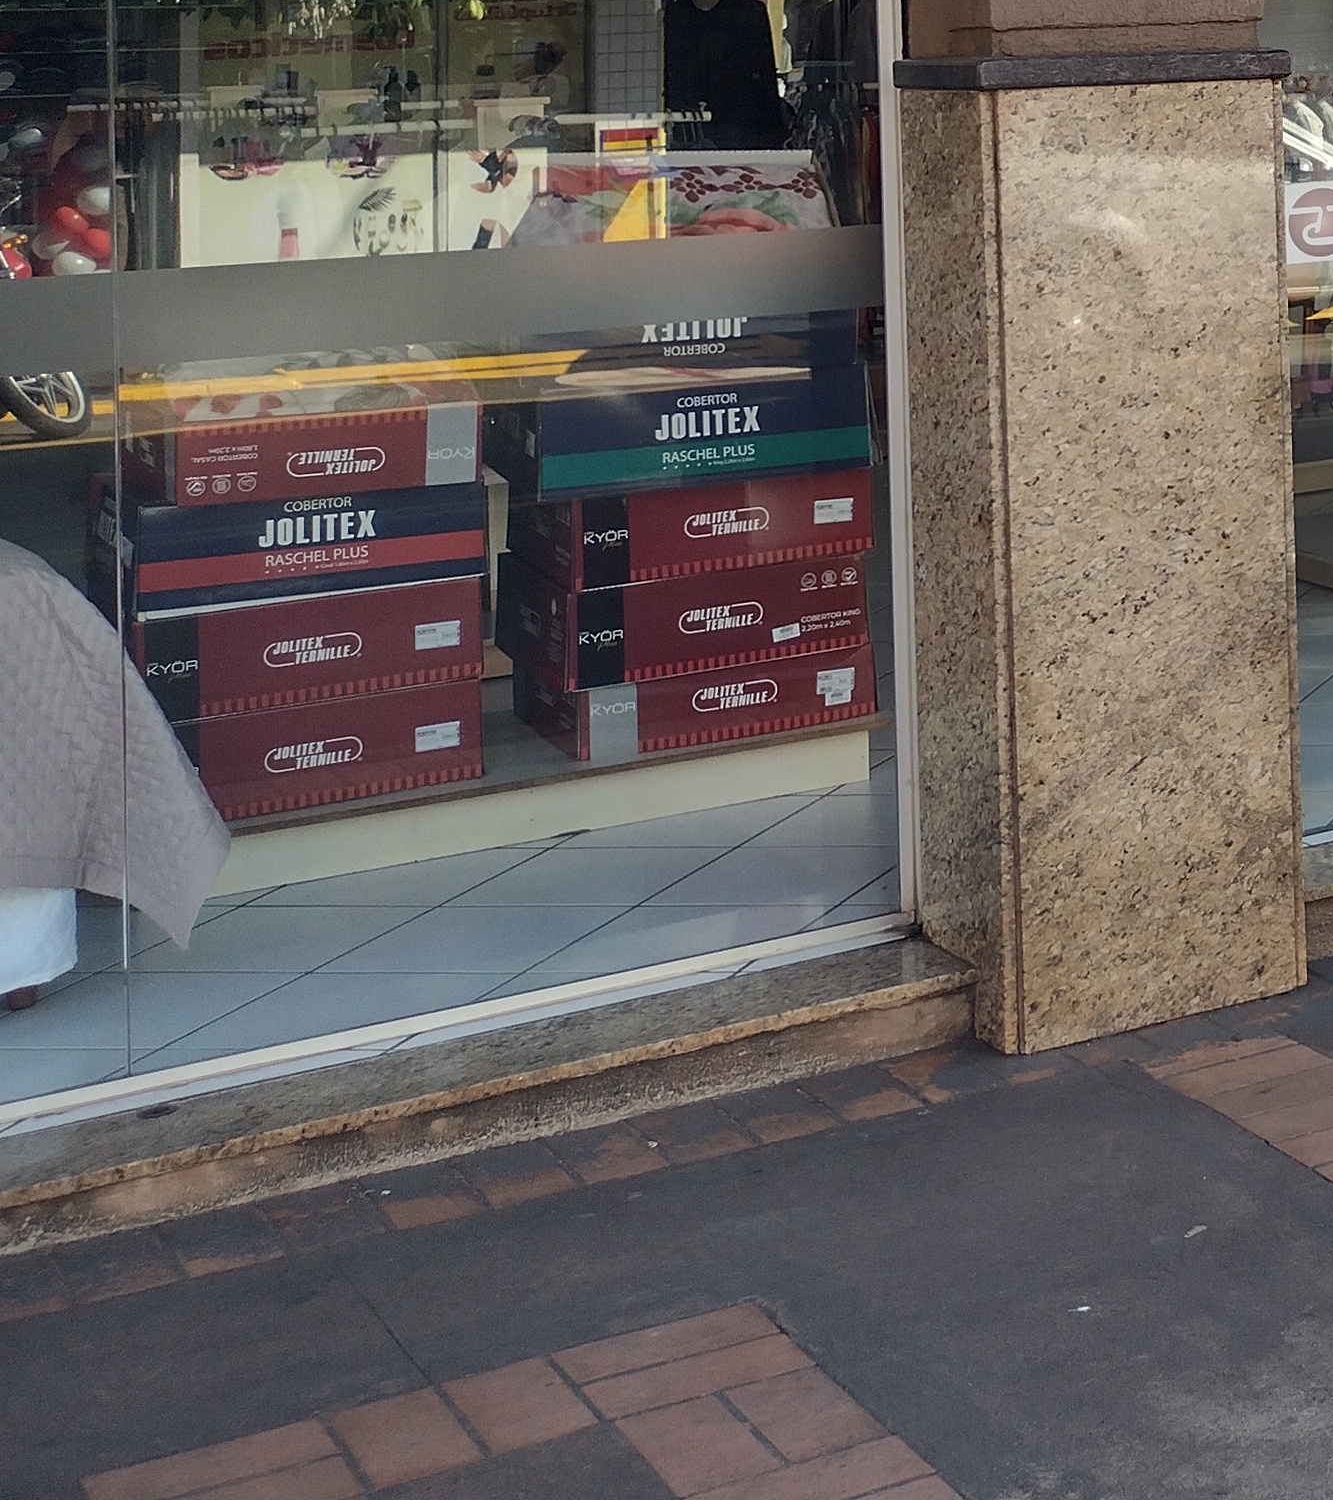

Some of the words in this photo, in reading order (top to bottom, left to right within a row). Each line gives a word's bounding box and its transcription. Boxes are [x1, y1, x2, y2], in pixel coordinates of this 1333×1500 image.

[664, 343, 726, 357] COBERTOR
[677, 393, 738, 409] COBERTOR
[655, 405, 760, 441] JOLITEX
[298, 449, 355, 465] TERNILLE
[662, 447, 721, 464] RASCHEL
[723, 444, 755, 457] PLUS
[326, 459, 376, 475] JOLITEX
[283, 496, 352, 514] COBERTOR
[692, 509, 737, 526] JOLITEX
[711, 518, 760, 535] TERNILLE
[258, 509, 376, 548] JOLITEX
[265, 548, 330, 567] RASCHEL
[333, 545, 369, 561] PLUS
[687, 605, 733, 623] JOLITEX
[705, 614, 754, 631] TERNILLE
[800, 611, 841, 623] COBERTOR
[273, 635, 324, 655] JOLITEX
[295, 644, 352, 665] TERNILLE
[699, 683, 746, 700] JOLITEX
[719, 691, 769, 709] TERNILLE
[273, 740, 324, 759] JOLITEX
[296, 749, 352, 770] TERNILLE
